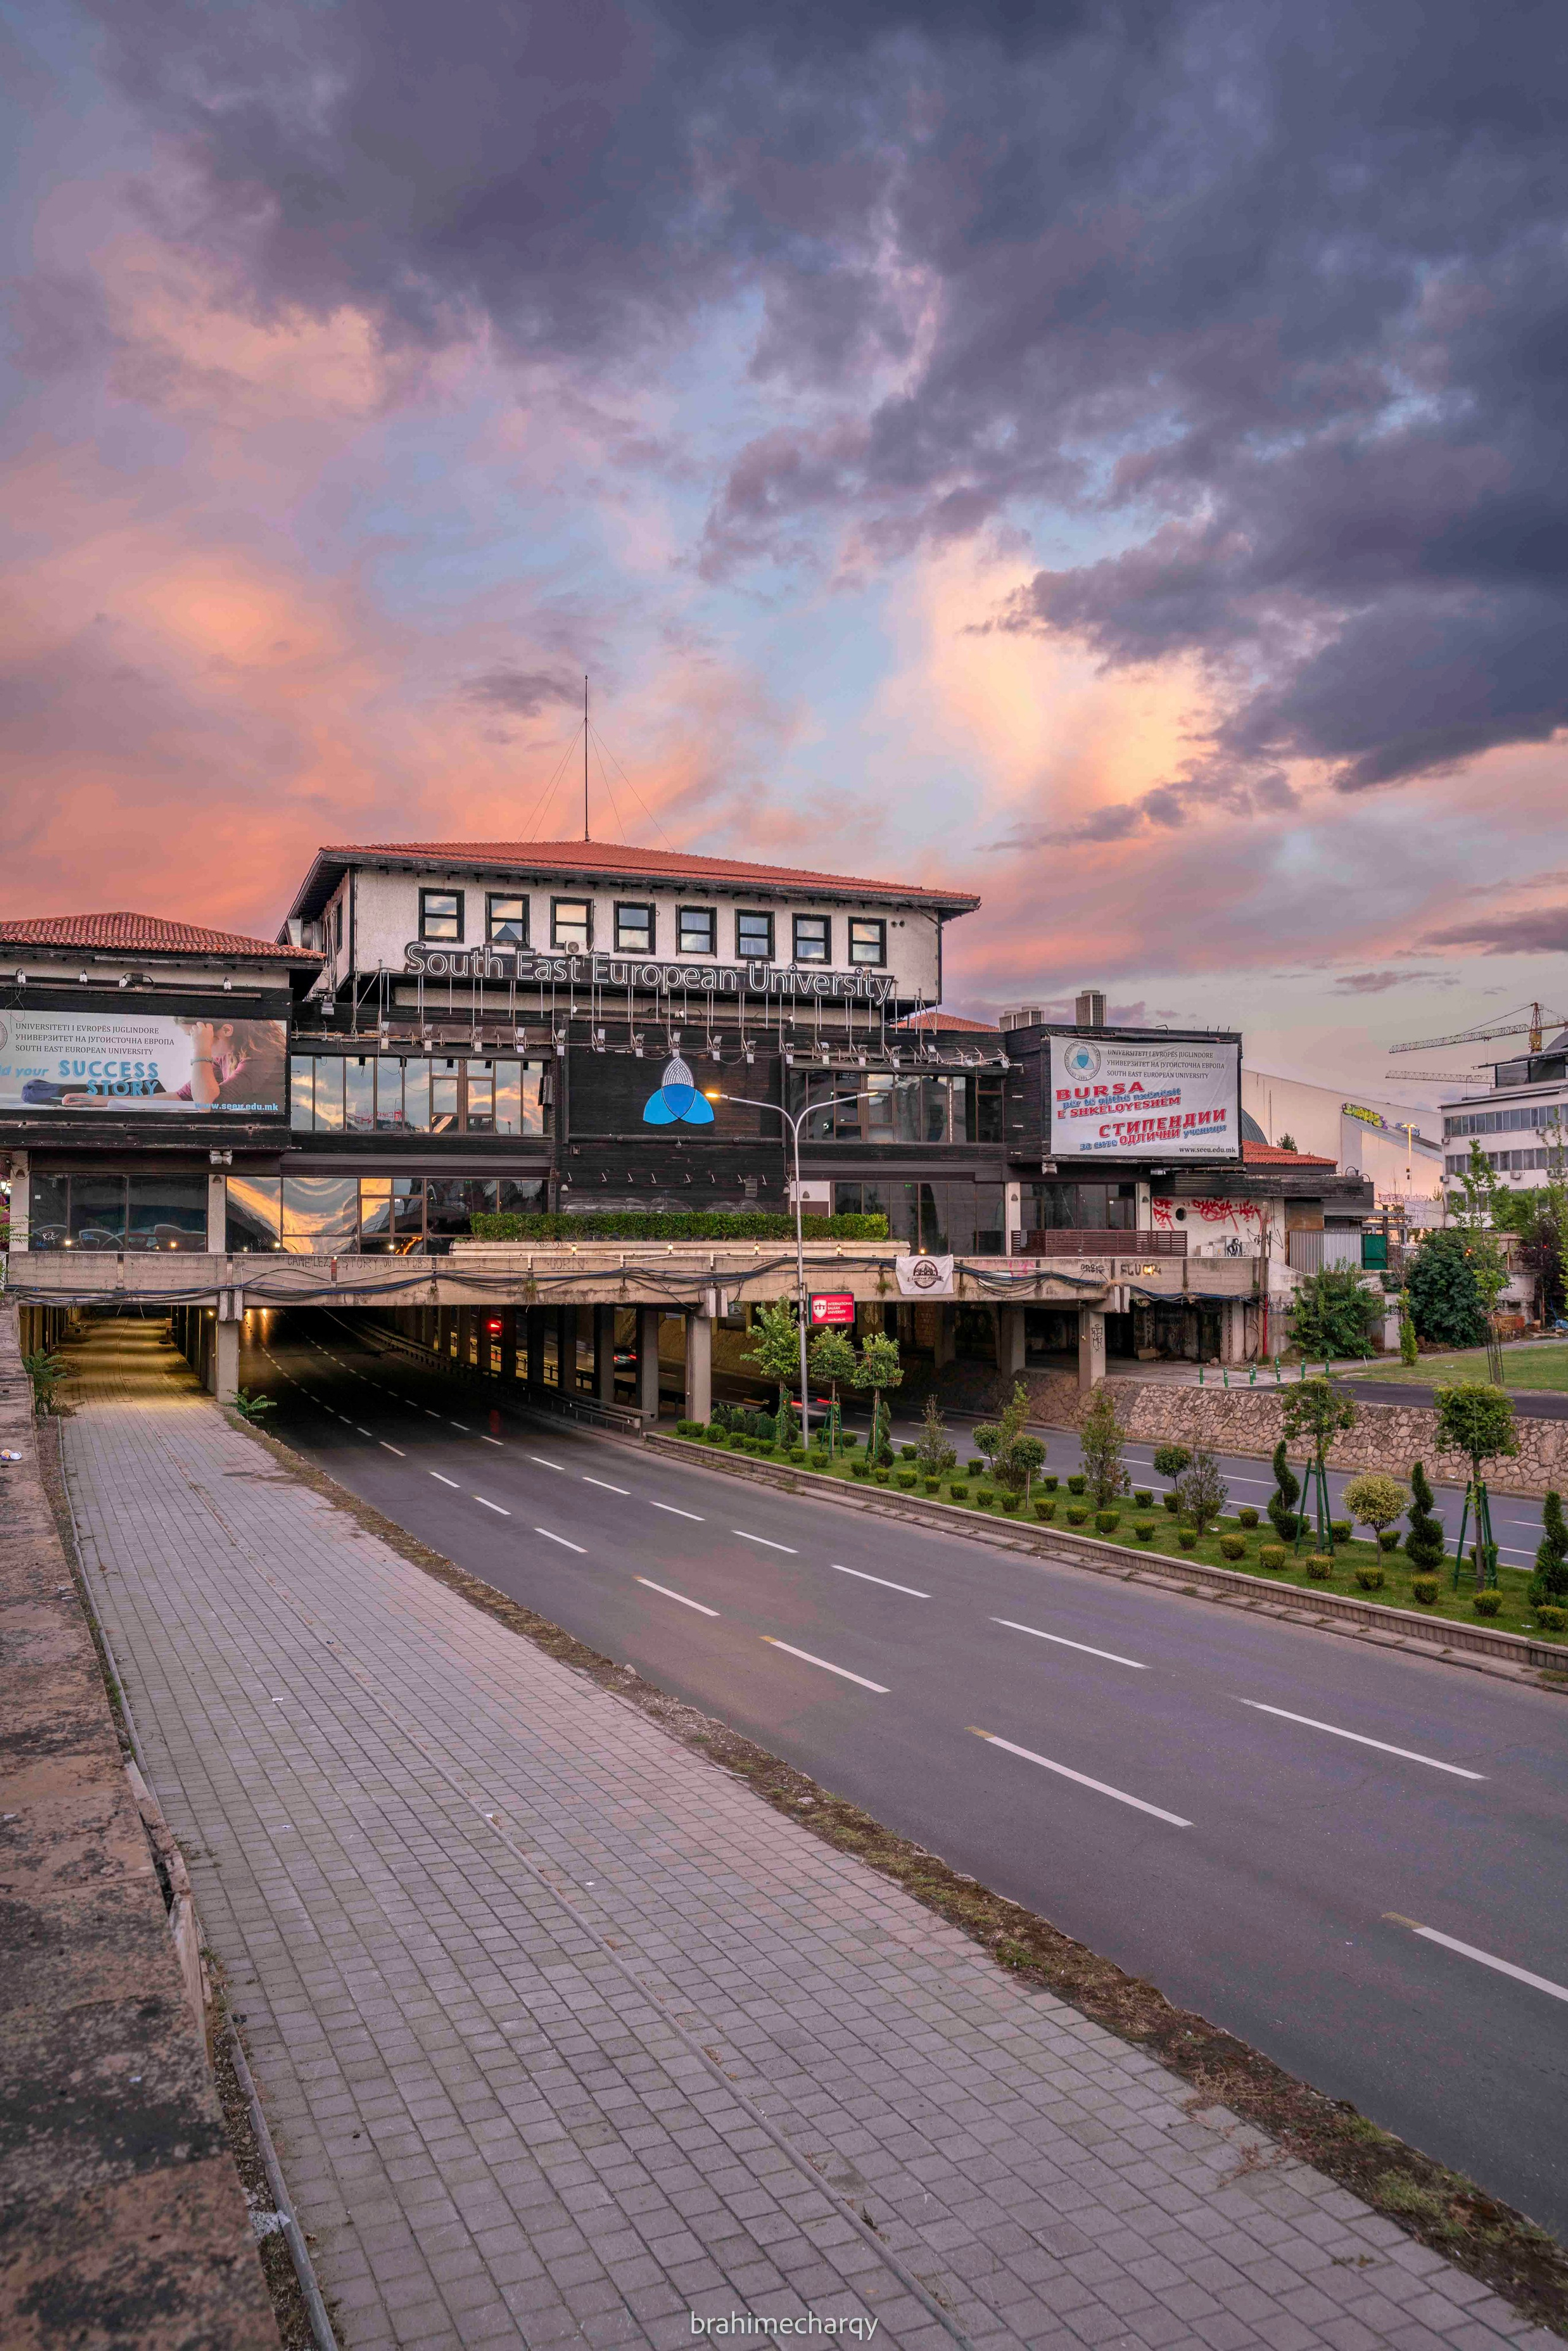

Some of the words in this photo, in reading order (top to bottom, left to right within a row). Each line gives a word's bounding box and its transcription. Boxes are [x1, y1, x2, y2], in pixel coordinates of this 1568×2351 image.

[407, 943, 503, 978] South
[517, 951, 581, 982] East
[593, 955, 736, 994] European
[749, 963, 892, 1005] University
[16, 1067, 49, 1078] your
[58, 1060, 159, 1079] SUCCESS
[87, 1079, 159, 1096] STORY
[1055, 1081, 1145, 1101] BURSA
[1057, 1109, 1066, 1119] E
[1063, 1100, 1081, 1109] për
[1099, 1108, 1227, 1138] СТИПЕНДИИ
[1119, 1128, 1181, 1145] ОДЛИЧНИ
[1183, 1125, 1227, 1139] ученици
